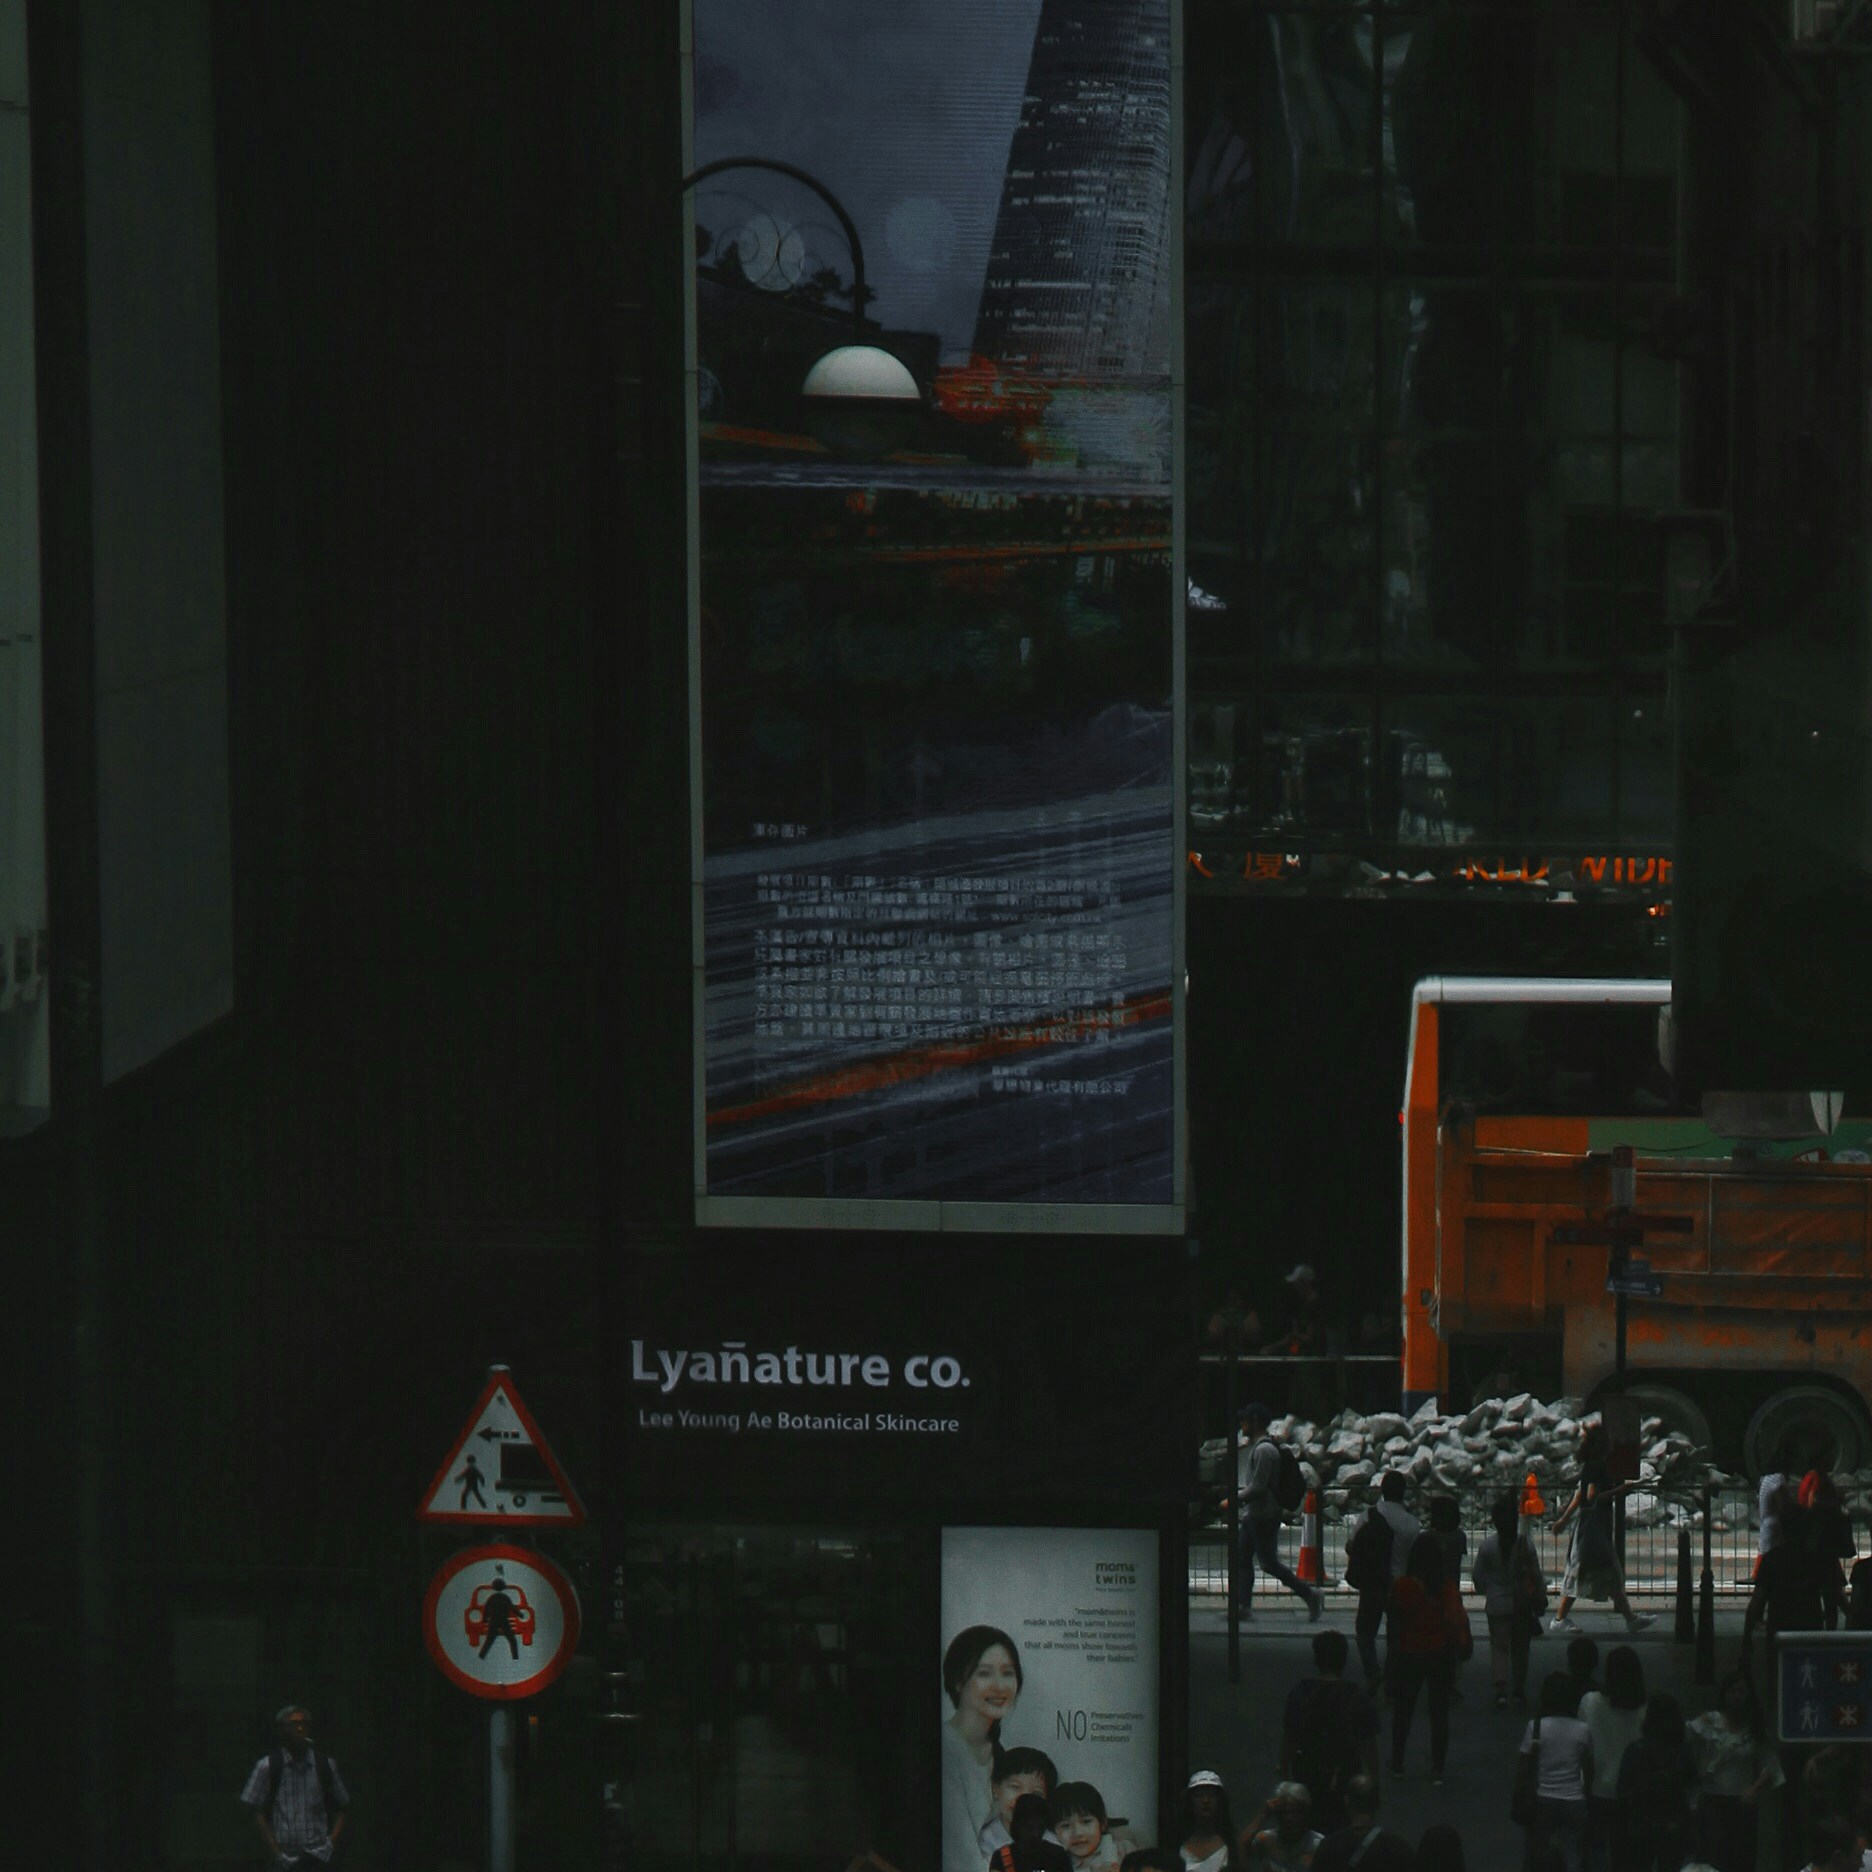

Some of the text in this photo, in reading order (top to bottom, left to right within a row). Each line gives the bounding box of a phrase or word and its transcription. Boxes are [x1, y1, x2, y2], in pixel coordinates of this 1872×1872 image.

[904, 1355, 971, 1388] co.
[639, 1409, 960, 1433] Lee Young Ae Botanical Skincare
[1096, 1574, 1136, 1584] twins
[1048, 1618, 1067, 1626] with
[1068, 1618, 1082, 1626] the
[1056, 1709, 1088, 1741] NO
[1091, 1722, 1132, 1731] Chemicals
